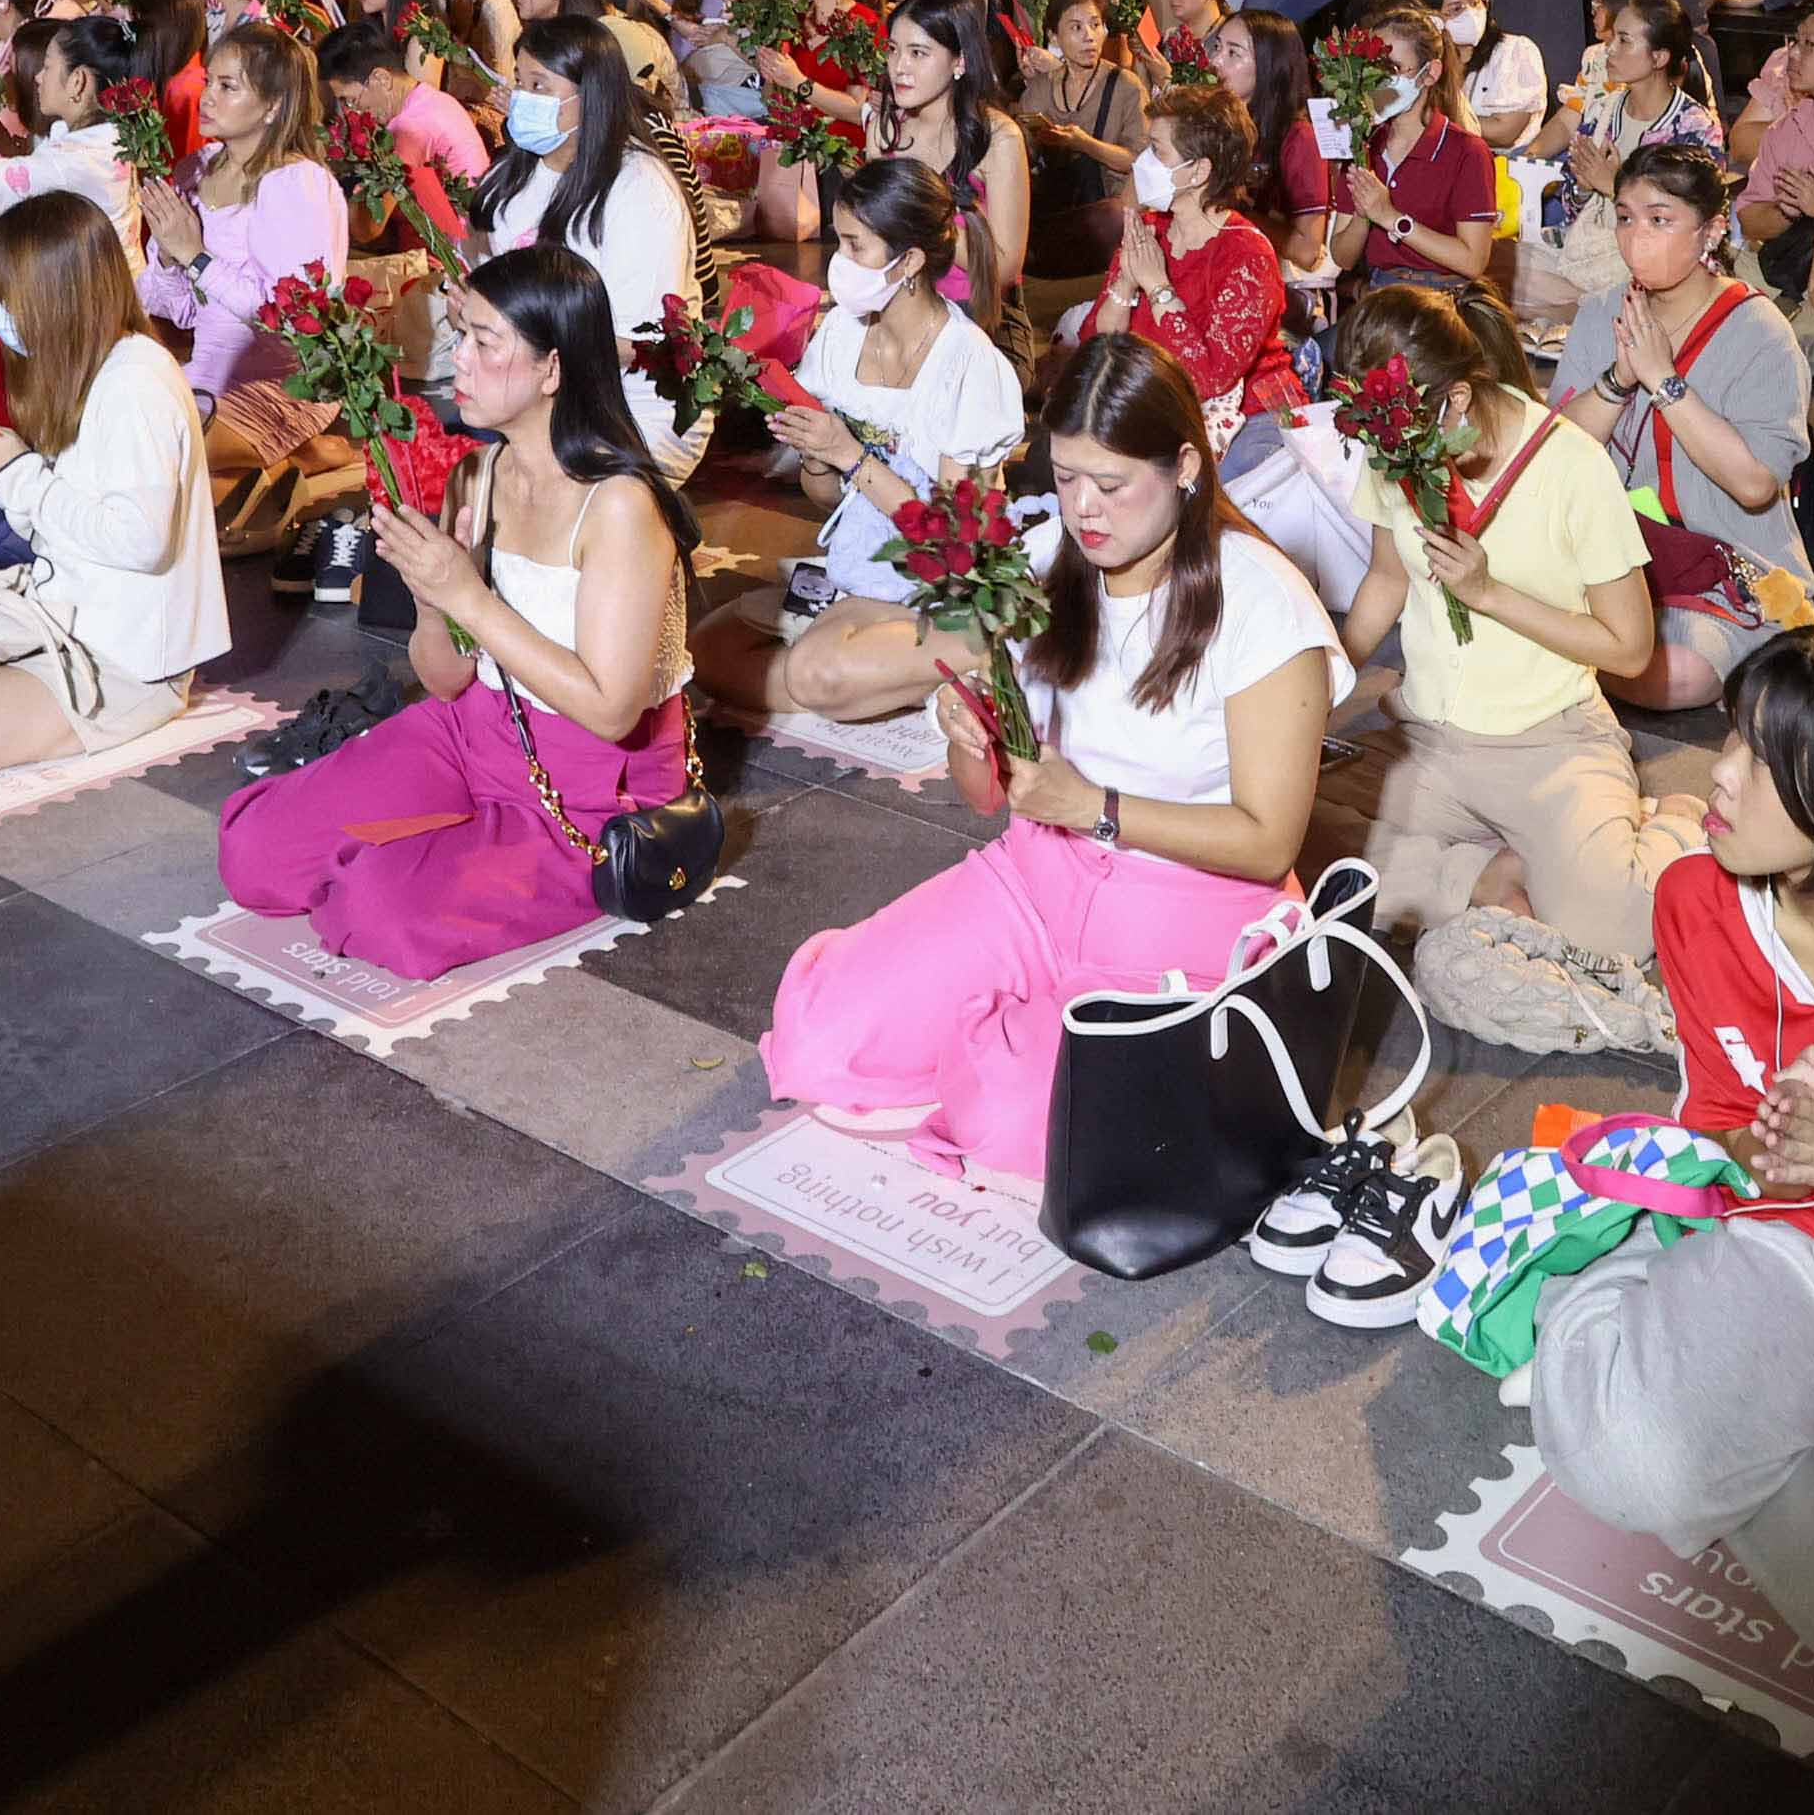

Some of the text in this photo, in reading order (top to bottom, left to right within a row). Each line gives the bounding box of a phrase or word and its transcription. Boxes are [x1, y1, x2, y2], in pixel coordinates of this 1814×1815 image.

[281, 941, 352, 976] stars
[337, 970, 401, 1004] told
[773, 1162, 1011, 1287] I wish nothing
[904, 1190, 1047, 1264] but you
[1691, 1547, 1763, 1595] ou
[1637, 1571, 1776, 1645] stars
